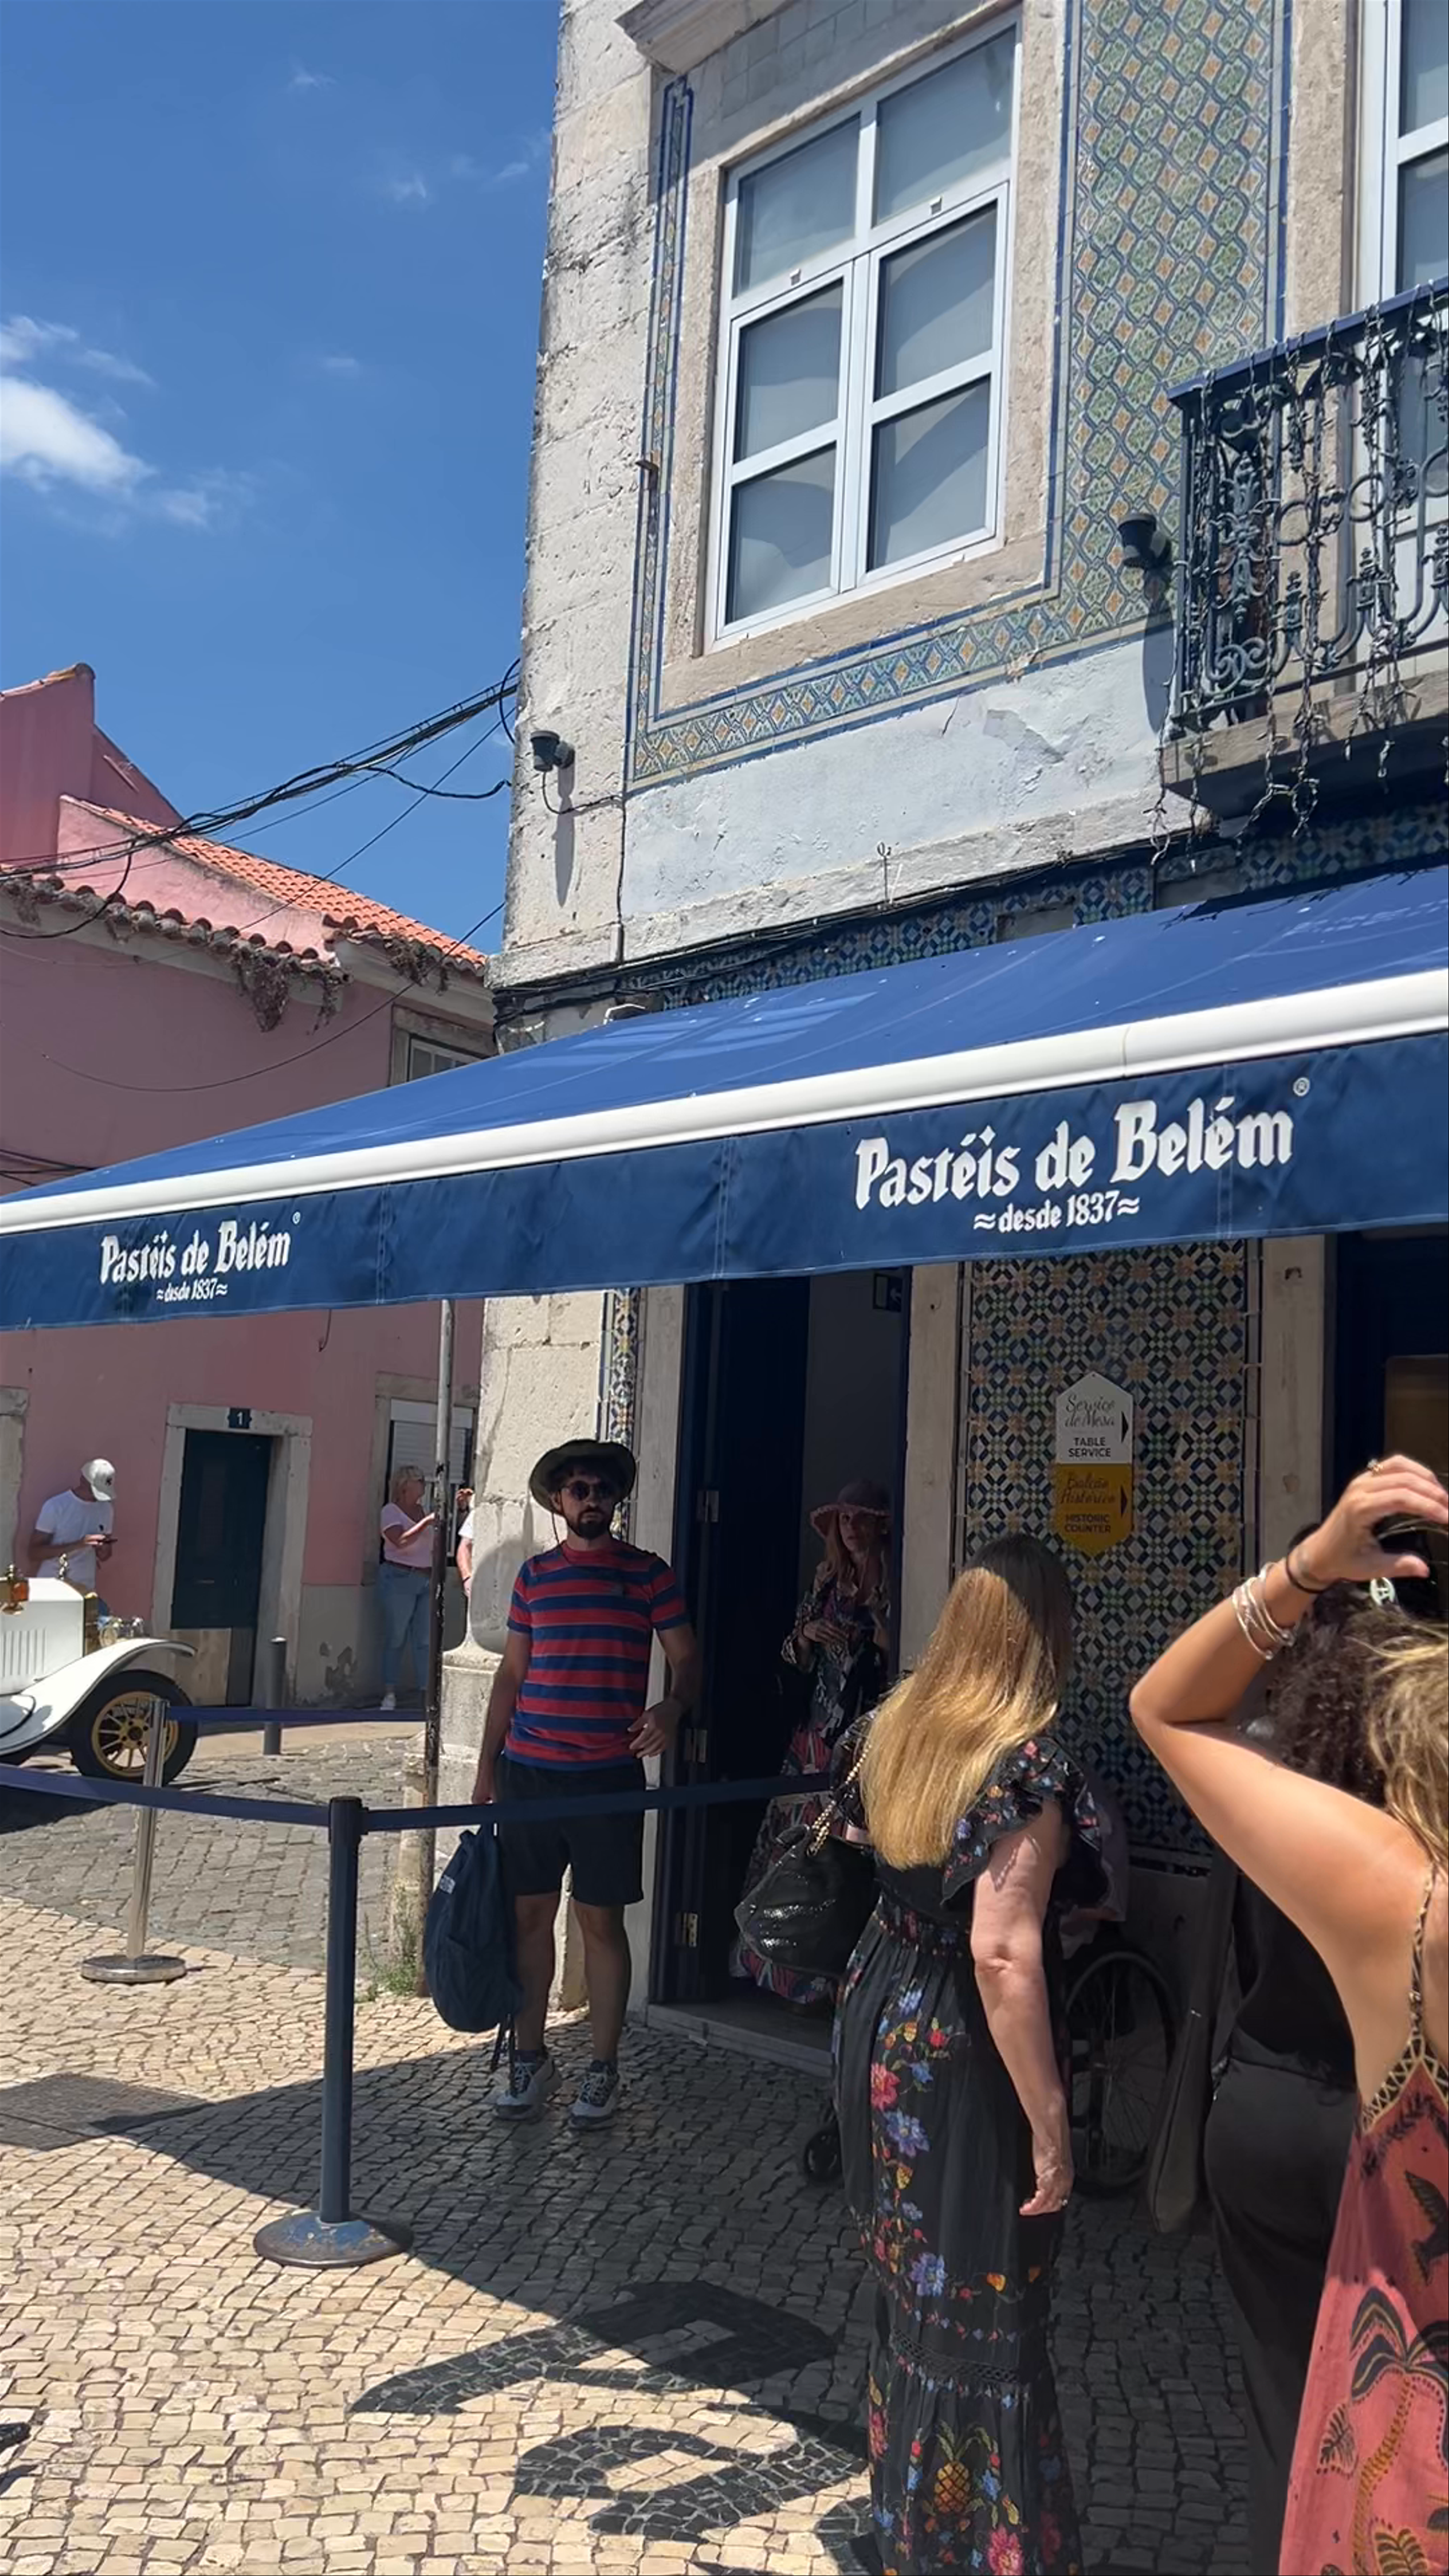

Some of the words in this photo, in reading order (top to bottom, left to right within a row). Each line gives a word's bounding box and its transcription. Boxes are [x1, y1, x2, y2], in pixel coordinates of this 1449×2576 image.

[855, 1126, 1021, 1210] Pastéis
[1035, 1121, 1095, 1192] de
[1109, 1097, 1294, 1183] Belém
[998, 1199, 1062, 1233] desde
[1066, 1190, 1120, 1227] 1837
[100, 1230, 177, 1284] Pastéis
[181, 1230, 209, 1276] de
[213, 1220, 291, 1273] Belém
[191, 1278, 218, 1300] 1837
[236, 1412, 243, 1425] 1
[1074, 1438, 1106, 1447] TABLE
[1069, 1448, 1111, 1457] SERVICE
[1064, 1524, 1112, 1533] COUNTER
